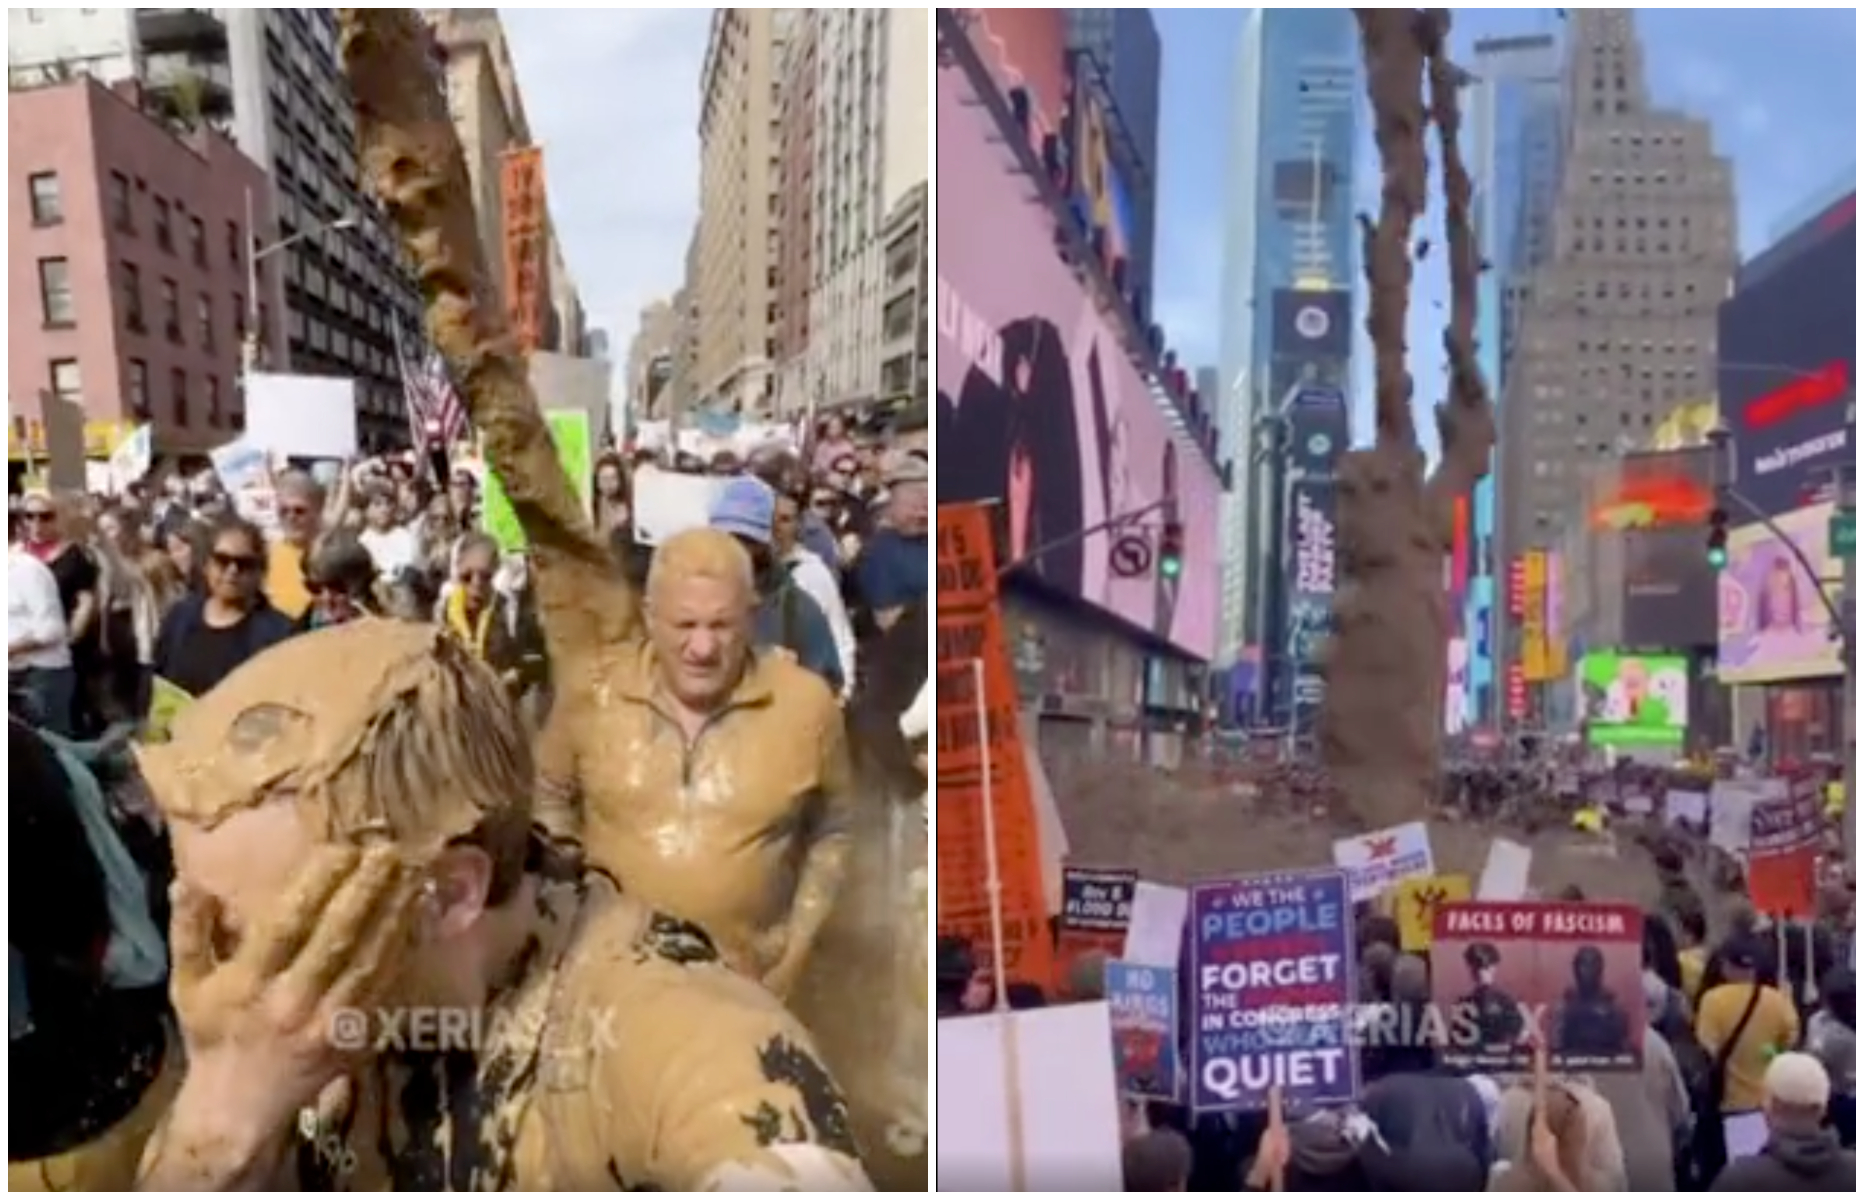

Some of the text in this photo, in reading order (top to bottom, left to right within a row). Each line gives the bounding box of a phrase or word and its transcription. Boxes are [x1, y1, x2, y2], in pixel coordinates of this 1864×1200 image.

[1232, 886, 1306, 909] WE THE
[1203, 902, 1338, 942] PEOPLE
[1446, 910, 1624, 934] FACES OF FASCISM
[1201, 953, 1341, 992] FORGET
[1203, 993, 1238, 1009] THE
[1202, 1014, 1224, 1031] IN
[1203, 1048, 1344, 1098] QUIET
